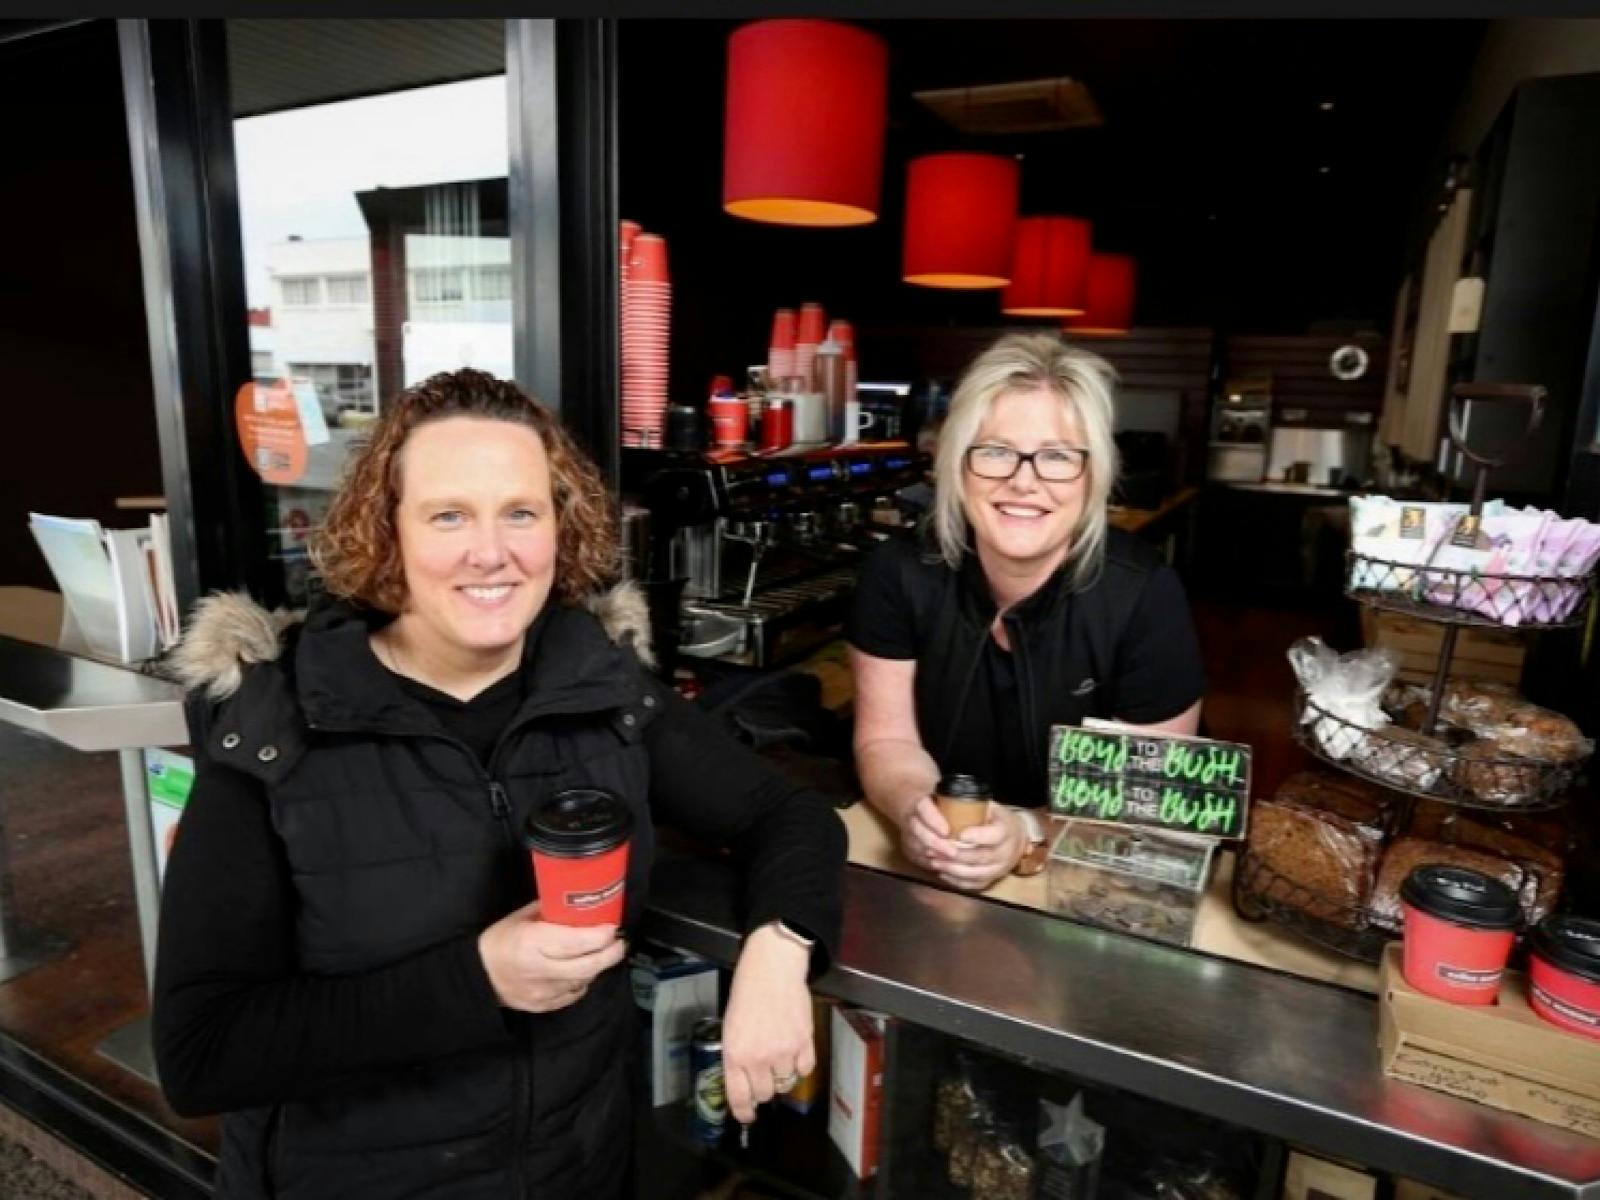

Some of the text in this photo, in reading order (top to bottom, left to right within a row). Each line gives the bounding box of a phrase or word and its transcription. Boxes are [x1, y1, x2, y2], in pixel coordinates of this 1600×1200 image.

[1137, 741, 1159, 756] TO
[1131, 756, 1162, 771] THE
[1132, 787, 1154, 801] TO
[1127, 802, 1158, 817] THE
